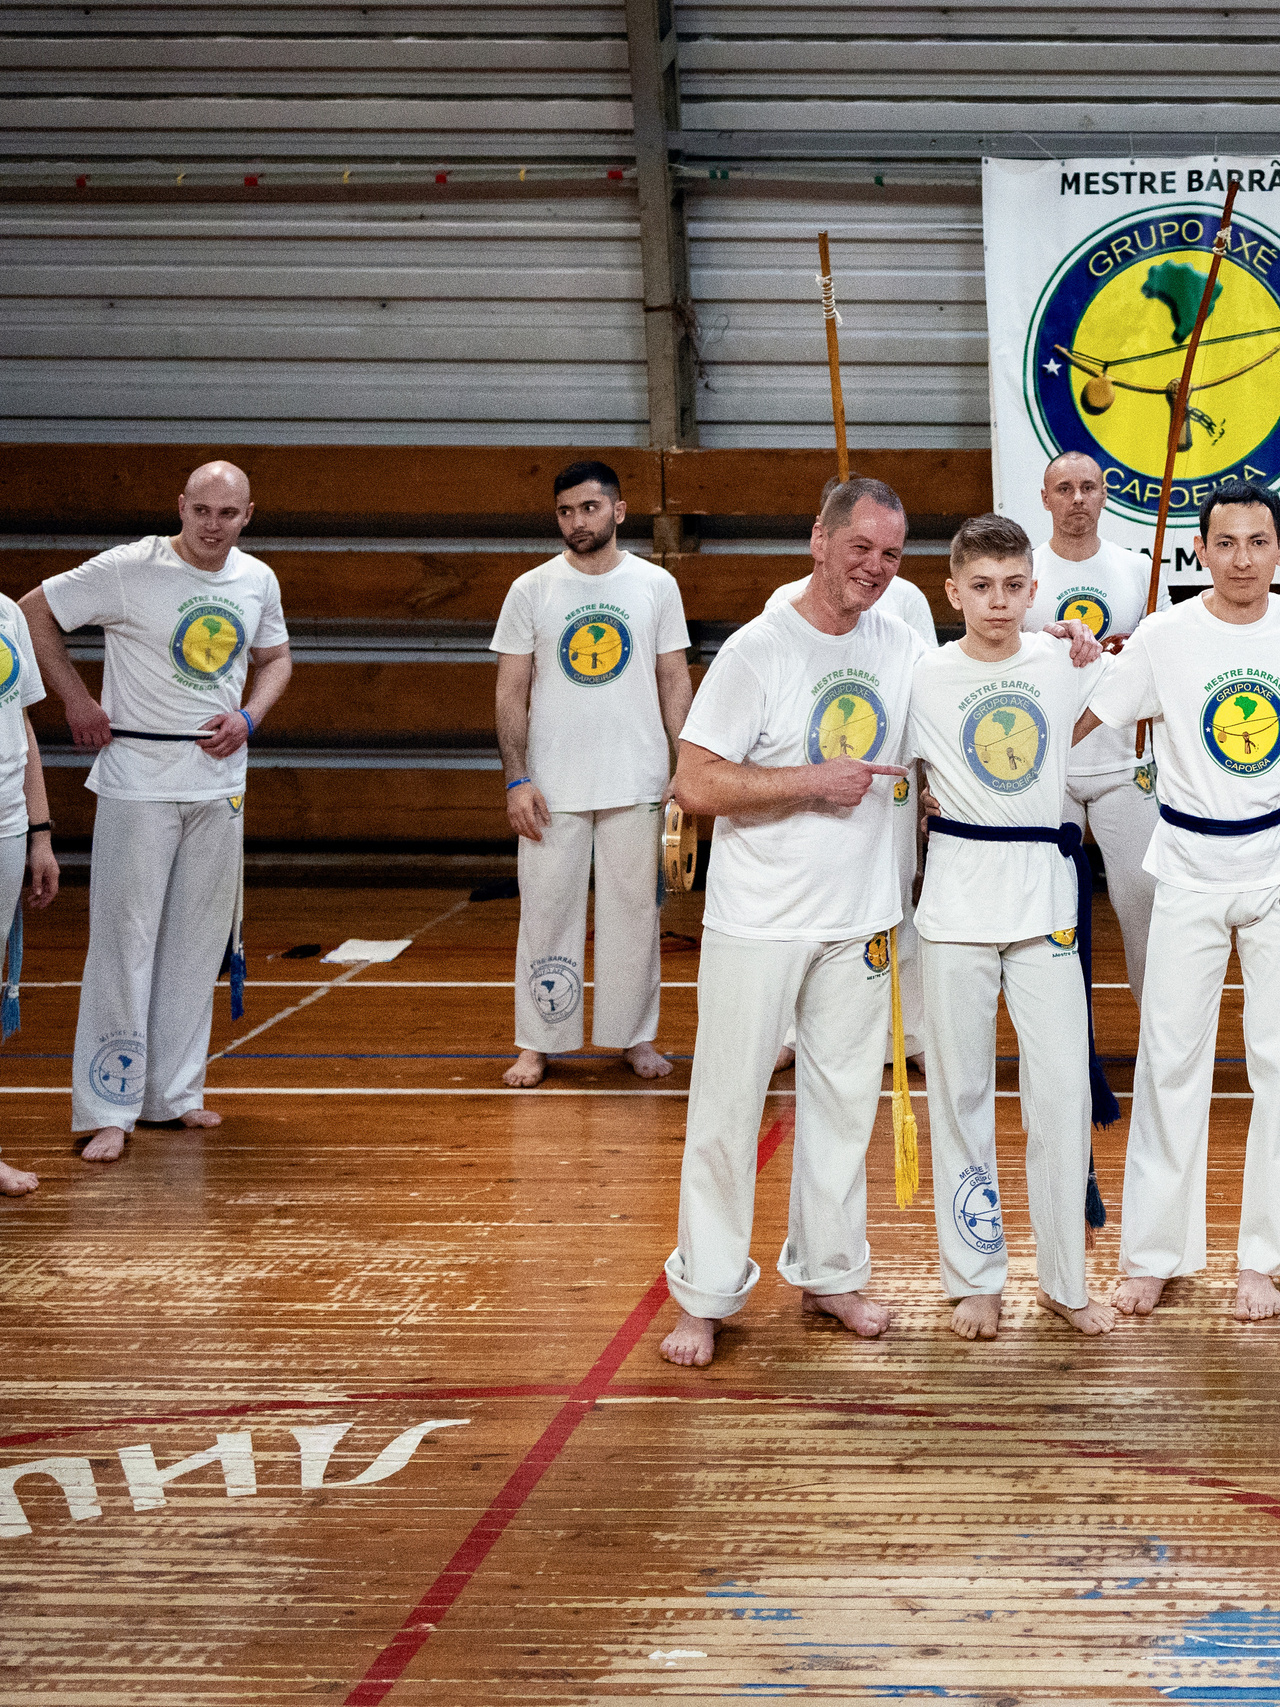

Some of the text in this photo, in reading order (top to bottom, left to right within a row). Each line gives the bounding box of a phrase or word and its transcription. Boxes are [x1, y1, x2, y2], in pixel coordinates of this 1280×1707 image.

[1060, 171, 1176, 195] MESTRE
[1089, 219, 1204, 277] GRUPO
[177, 595, 210, 614] MESTRE
[1056, 586, 1080, 601] MESTRE
[564, 602, 630, 622] MESTRE BARRÃO
[811, 667, 881, 697] MESTRE BARRÃO
[1203, 668, 1244, 693] MESTRE
[4, 689, 20, 705] YAN
[958, 680, 1041, 713] MESTRE BARRÃO
[1216, 682, 1252, 703] GRUPO
[972, 696, 1009, 721] GRUPO
[1224, 757, 1272, 773] CAPOEIRA
